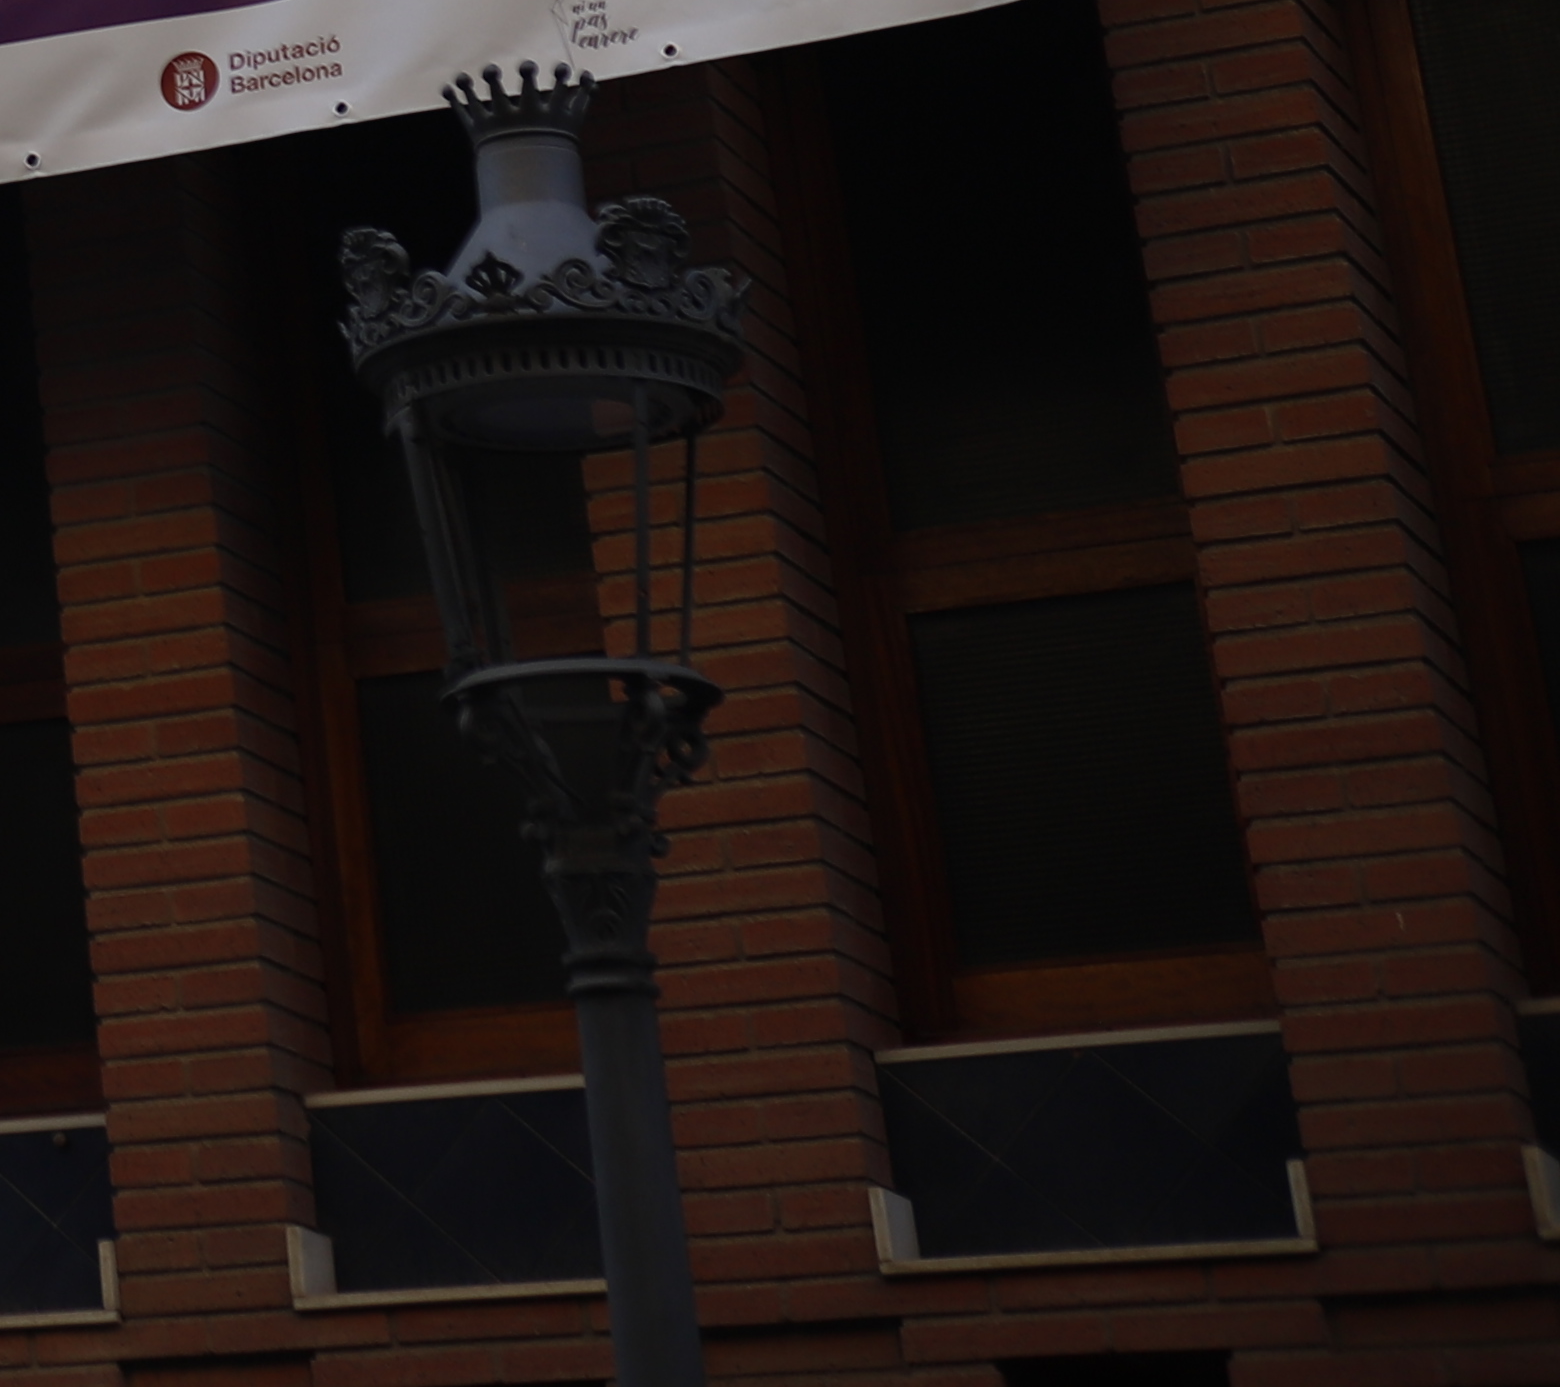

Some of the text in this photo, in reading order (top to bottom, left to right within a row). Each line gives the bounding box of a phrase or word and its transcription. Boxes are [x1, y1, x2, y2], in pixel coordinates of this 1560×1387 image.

[571, 13, 607, 43] pas
[228, 35, 341, 71] Diputació
[230, 61, 343, 94] Barcelona
